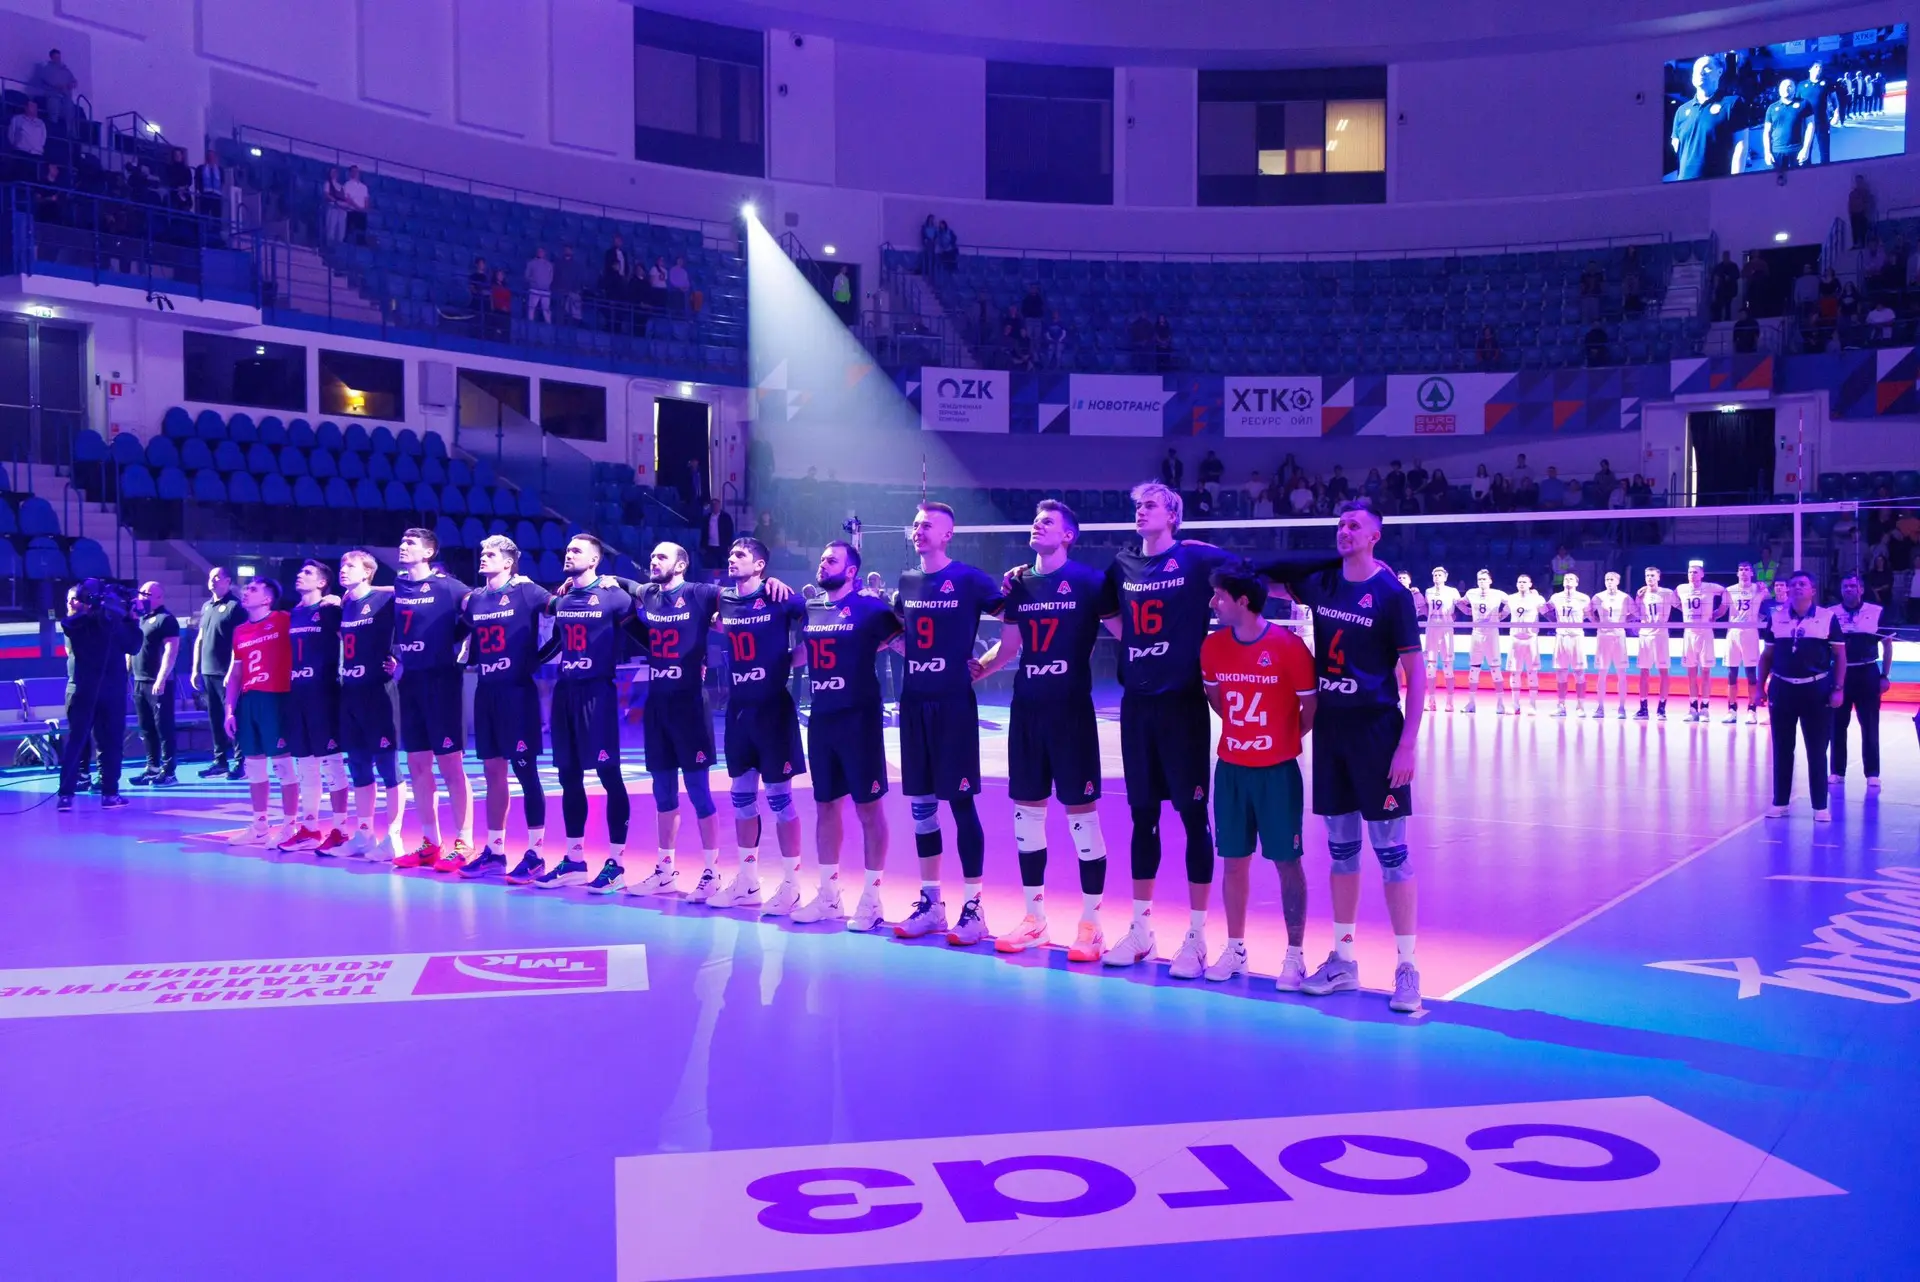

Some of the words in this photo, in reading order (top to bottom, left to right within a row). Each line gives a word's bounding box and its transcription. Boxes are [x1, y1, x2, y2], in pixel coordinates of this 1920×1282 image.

[937, 378, 994, 399] OZK
[1088, 400, 1161, 412] НОВОТРАНС
[1241, 416, 1281, 426] РЕСУРС
[1290, 415, 1313, 425] ОЙЛ
[1416, 416, 1455, 424] EURO
[1416, 424, 1455, 432] SPAR
[1123, 577, 1185, 592] ЛОКОМОТИВ
[1018, 601, 1076, 612] ЛОКОМОТИВ
[1431, 599, 1443, 611] 19
[1479, 603, 1487, 614] 8
[1516, 607, 1525, 618] 9
[1562, 606, 1573, 617] 17
[1609, 606, 1613, 618] 1
[1648, 603, 1658, 616] 11
[1687, 597, 1701, 609] 10
[1737, 599, 1751, 611] 13
[401, 610, 414, 635] 7
[1130, 599, 1164, 635] 16
[477, 625, 506, 654] 23
[564, 623, 587, 652] 18
[916, 616, 935, 649] 9
[1029, 618, 1059, 653] 17
[344, 633, 356, 659] 8
[649, 628, 679, 659] 22
[728, 631, 756, 662] 10
[1328, 628, 1345, 665] 4
[248, 650, 262, 673] 2
[808, 638, 837, 670] 15
[1226, 690, 1267, 726] 24
[124, 960, 394, 979] КОМПАНИЯ
[481, 955, 596, 973] ТМК
[0, 972, 387, 997] МЕТАЛЛУРГИЧЕ
[153, 985, 378, 1004] ТРУБНАЯ
